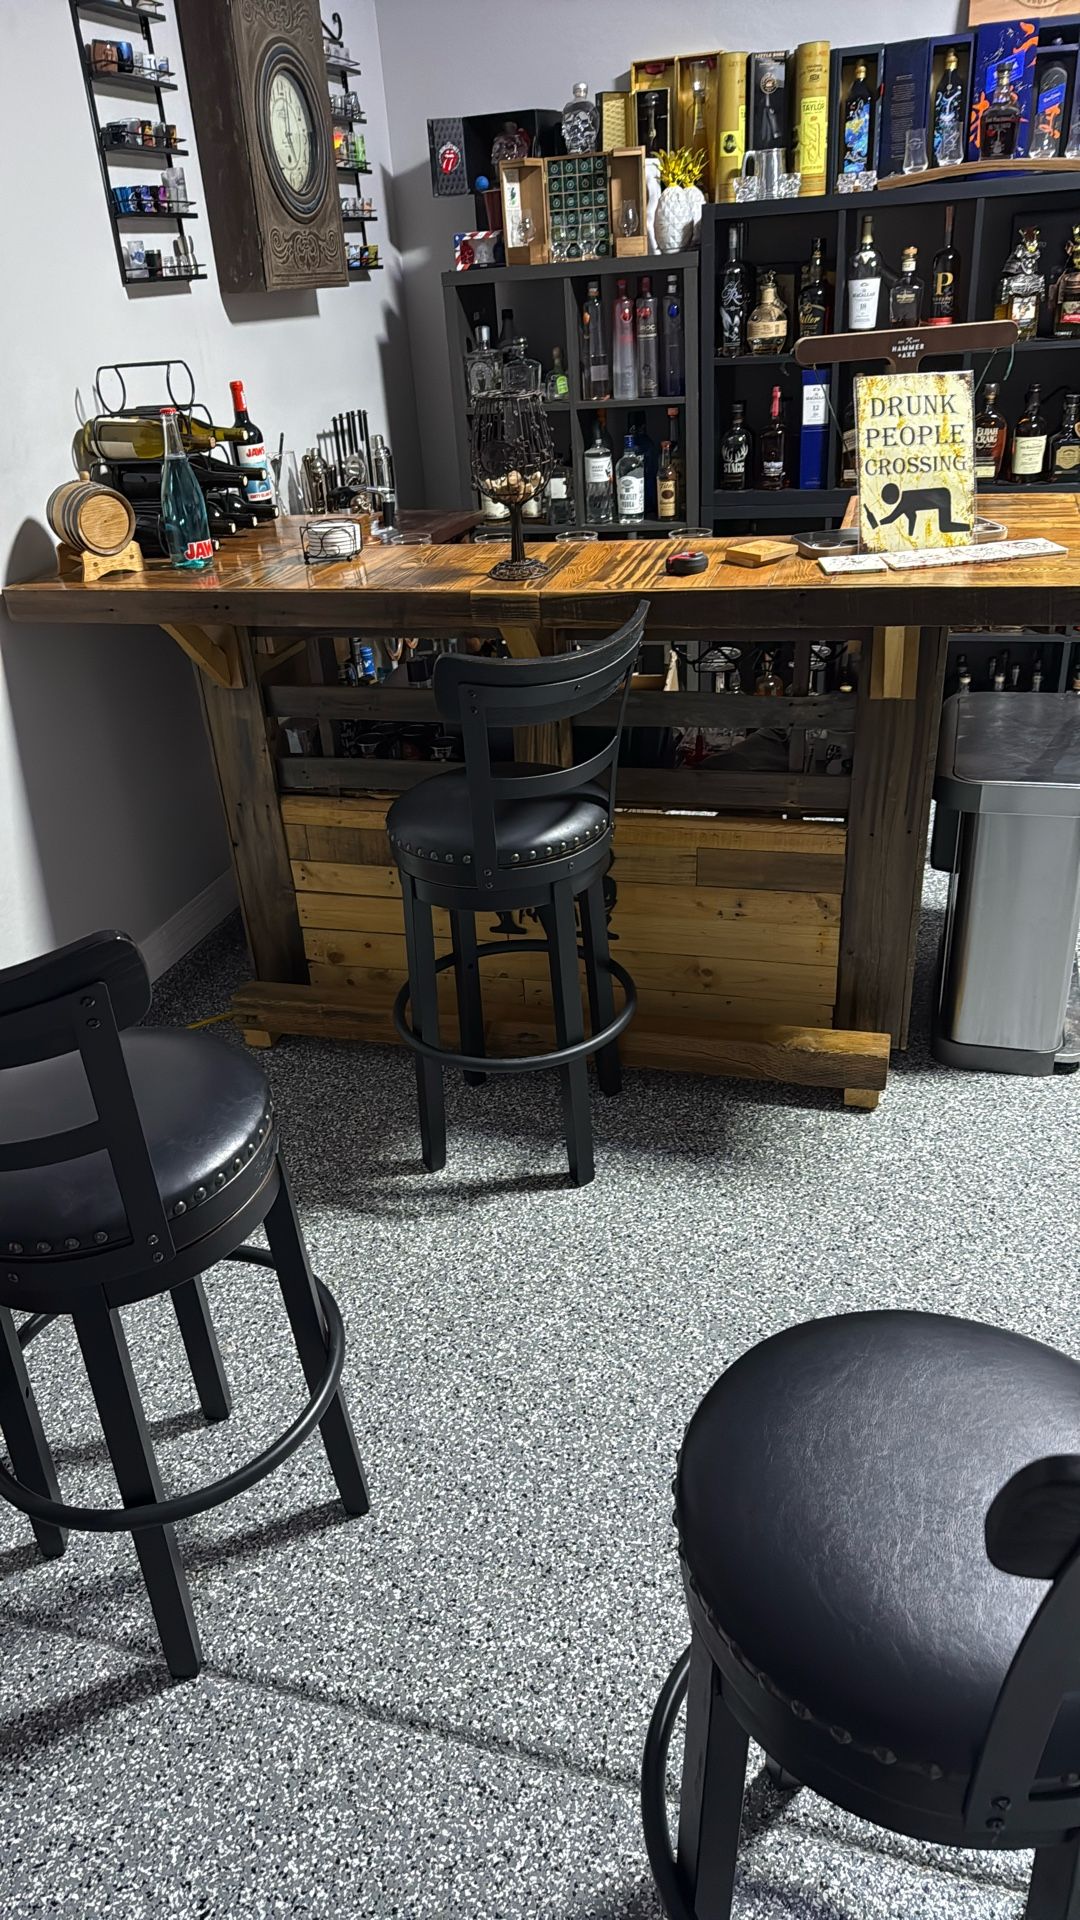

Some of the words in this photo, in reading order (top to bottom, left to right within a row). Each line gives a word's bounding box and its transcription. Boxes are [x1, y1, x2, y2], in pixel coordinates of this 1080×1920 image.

[935, 271, 954, 296] P
[891, 343, 925, 352] HAMMER
[870, 394, 958, 416] DRUNK
[865, 424, 965, 448] PEOPLE
[976, 427, 999, 435] ELIJAH
[975, 435, 998, 443] CRAIG
[246, 446, 266, 458] JAWS
[723, 462, 745, 473] STAGG
[865, 456, 967, 476] CROSSING
